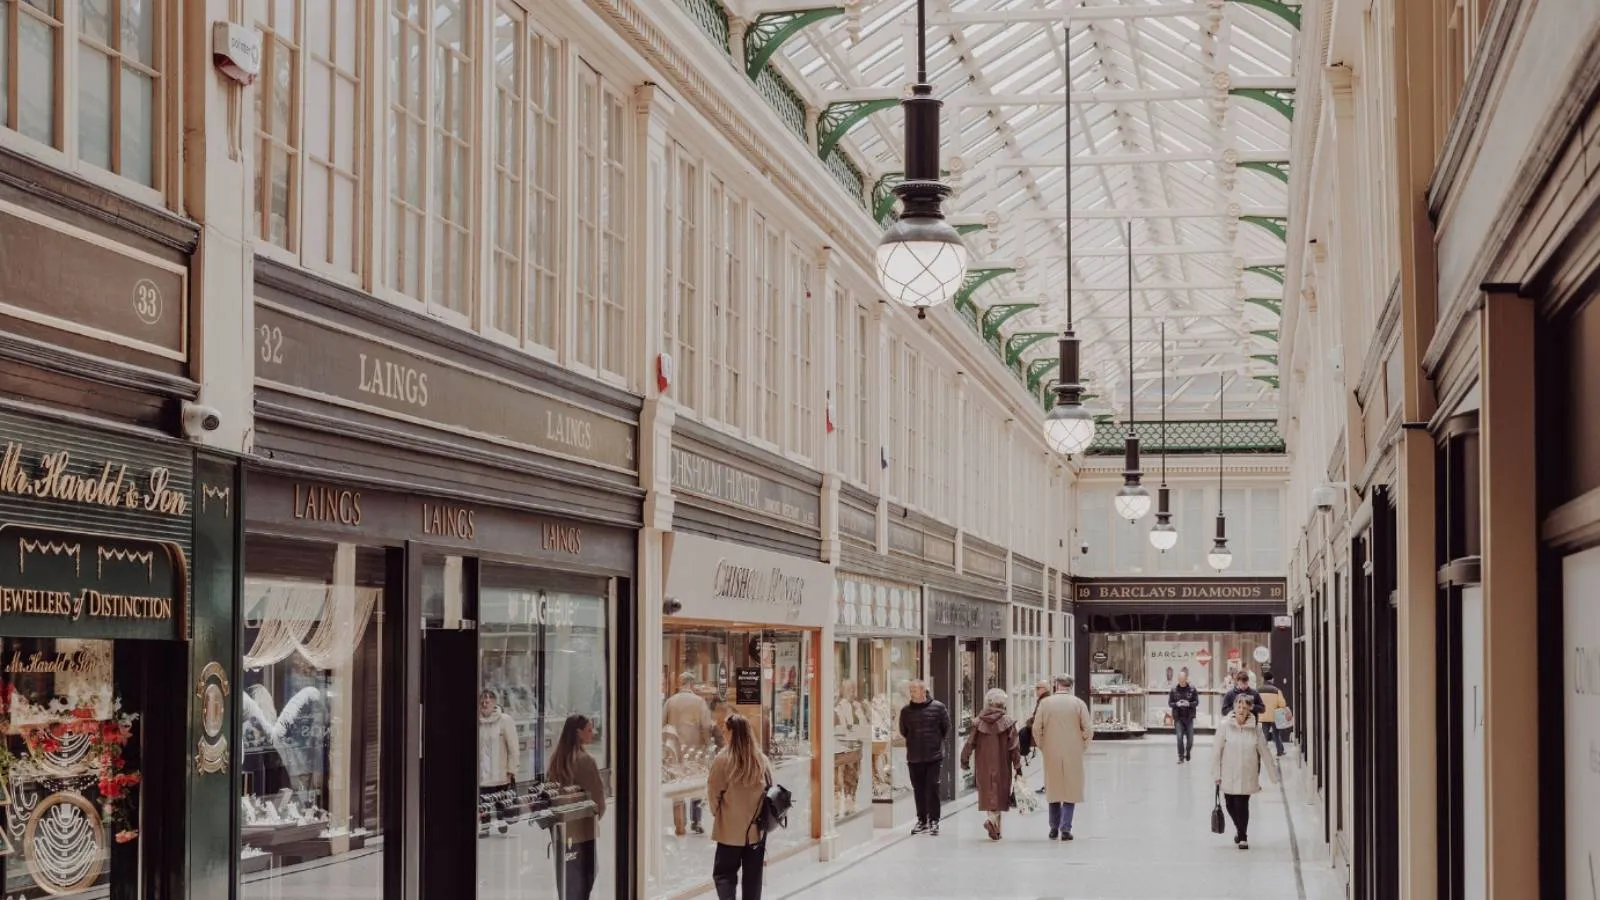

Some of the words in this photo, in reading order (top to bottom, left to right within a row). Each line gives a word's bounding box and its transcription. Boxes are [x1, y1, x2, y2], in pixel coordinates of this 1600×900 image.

[137, 284, 157, 317] 33
[260, 323, 284, 364] 32
[358, 353, 429, 407] LAINGS
[546, 410, 592, 450] LAINGS
[0, 441, 33, 494] Mr.
[35, 450, 127, 506] Harold
[125, 481, 139, 509] &
[144, 466, 187, 516] Son
[294, 483, 362, 527] LAINGS
[422, 502, 476, 541] LAINGS
[540, 522, 582, 555] LAINGS
[0, 586, 72, 616] JEWELLERS
[73, 588, 89, 621] of
[90, 590, 172, 620] DISTINCTION
[1079, 588, 1091, 598] 19
[1099, 586, 1177, 598] BARCLAYS
[1181, 586, 1262, 598] DIAMONDS
[1269, 587, 1282, 598] 19
